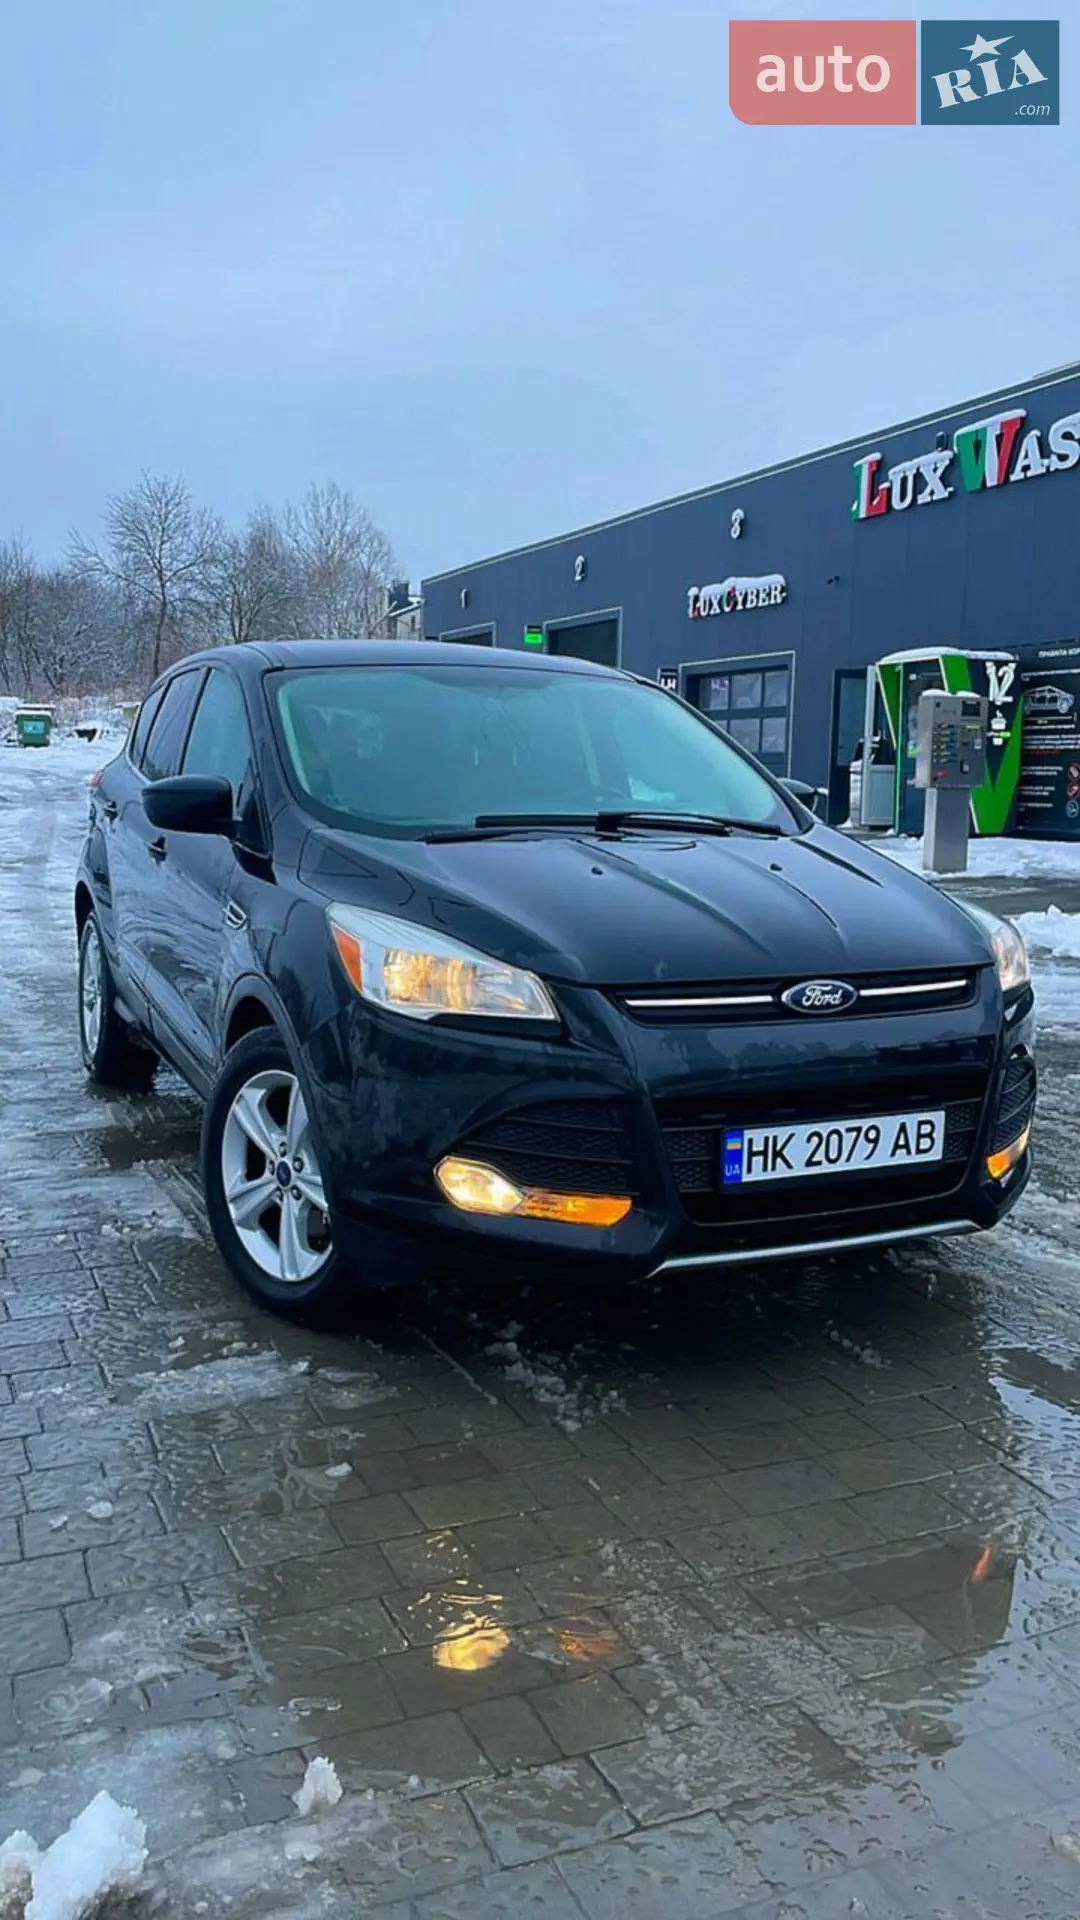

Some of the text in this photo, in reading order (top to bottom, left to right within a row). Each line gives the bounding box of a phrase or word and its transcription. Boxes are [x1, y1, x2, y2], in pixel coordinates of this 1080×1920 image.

[574, 554, 585, 581] 2
[802, 985, 844, 1007] Ford
[746, 1119, 937, 1175] HK 2079 AB
[725, 1165, 740, 1177] UA
